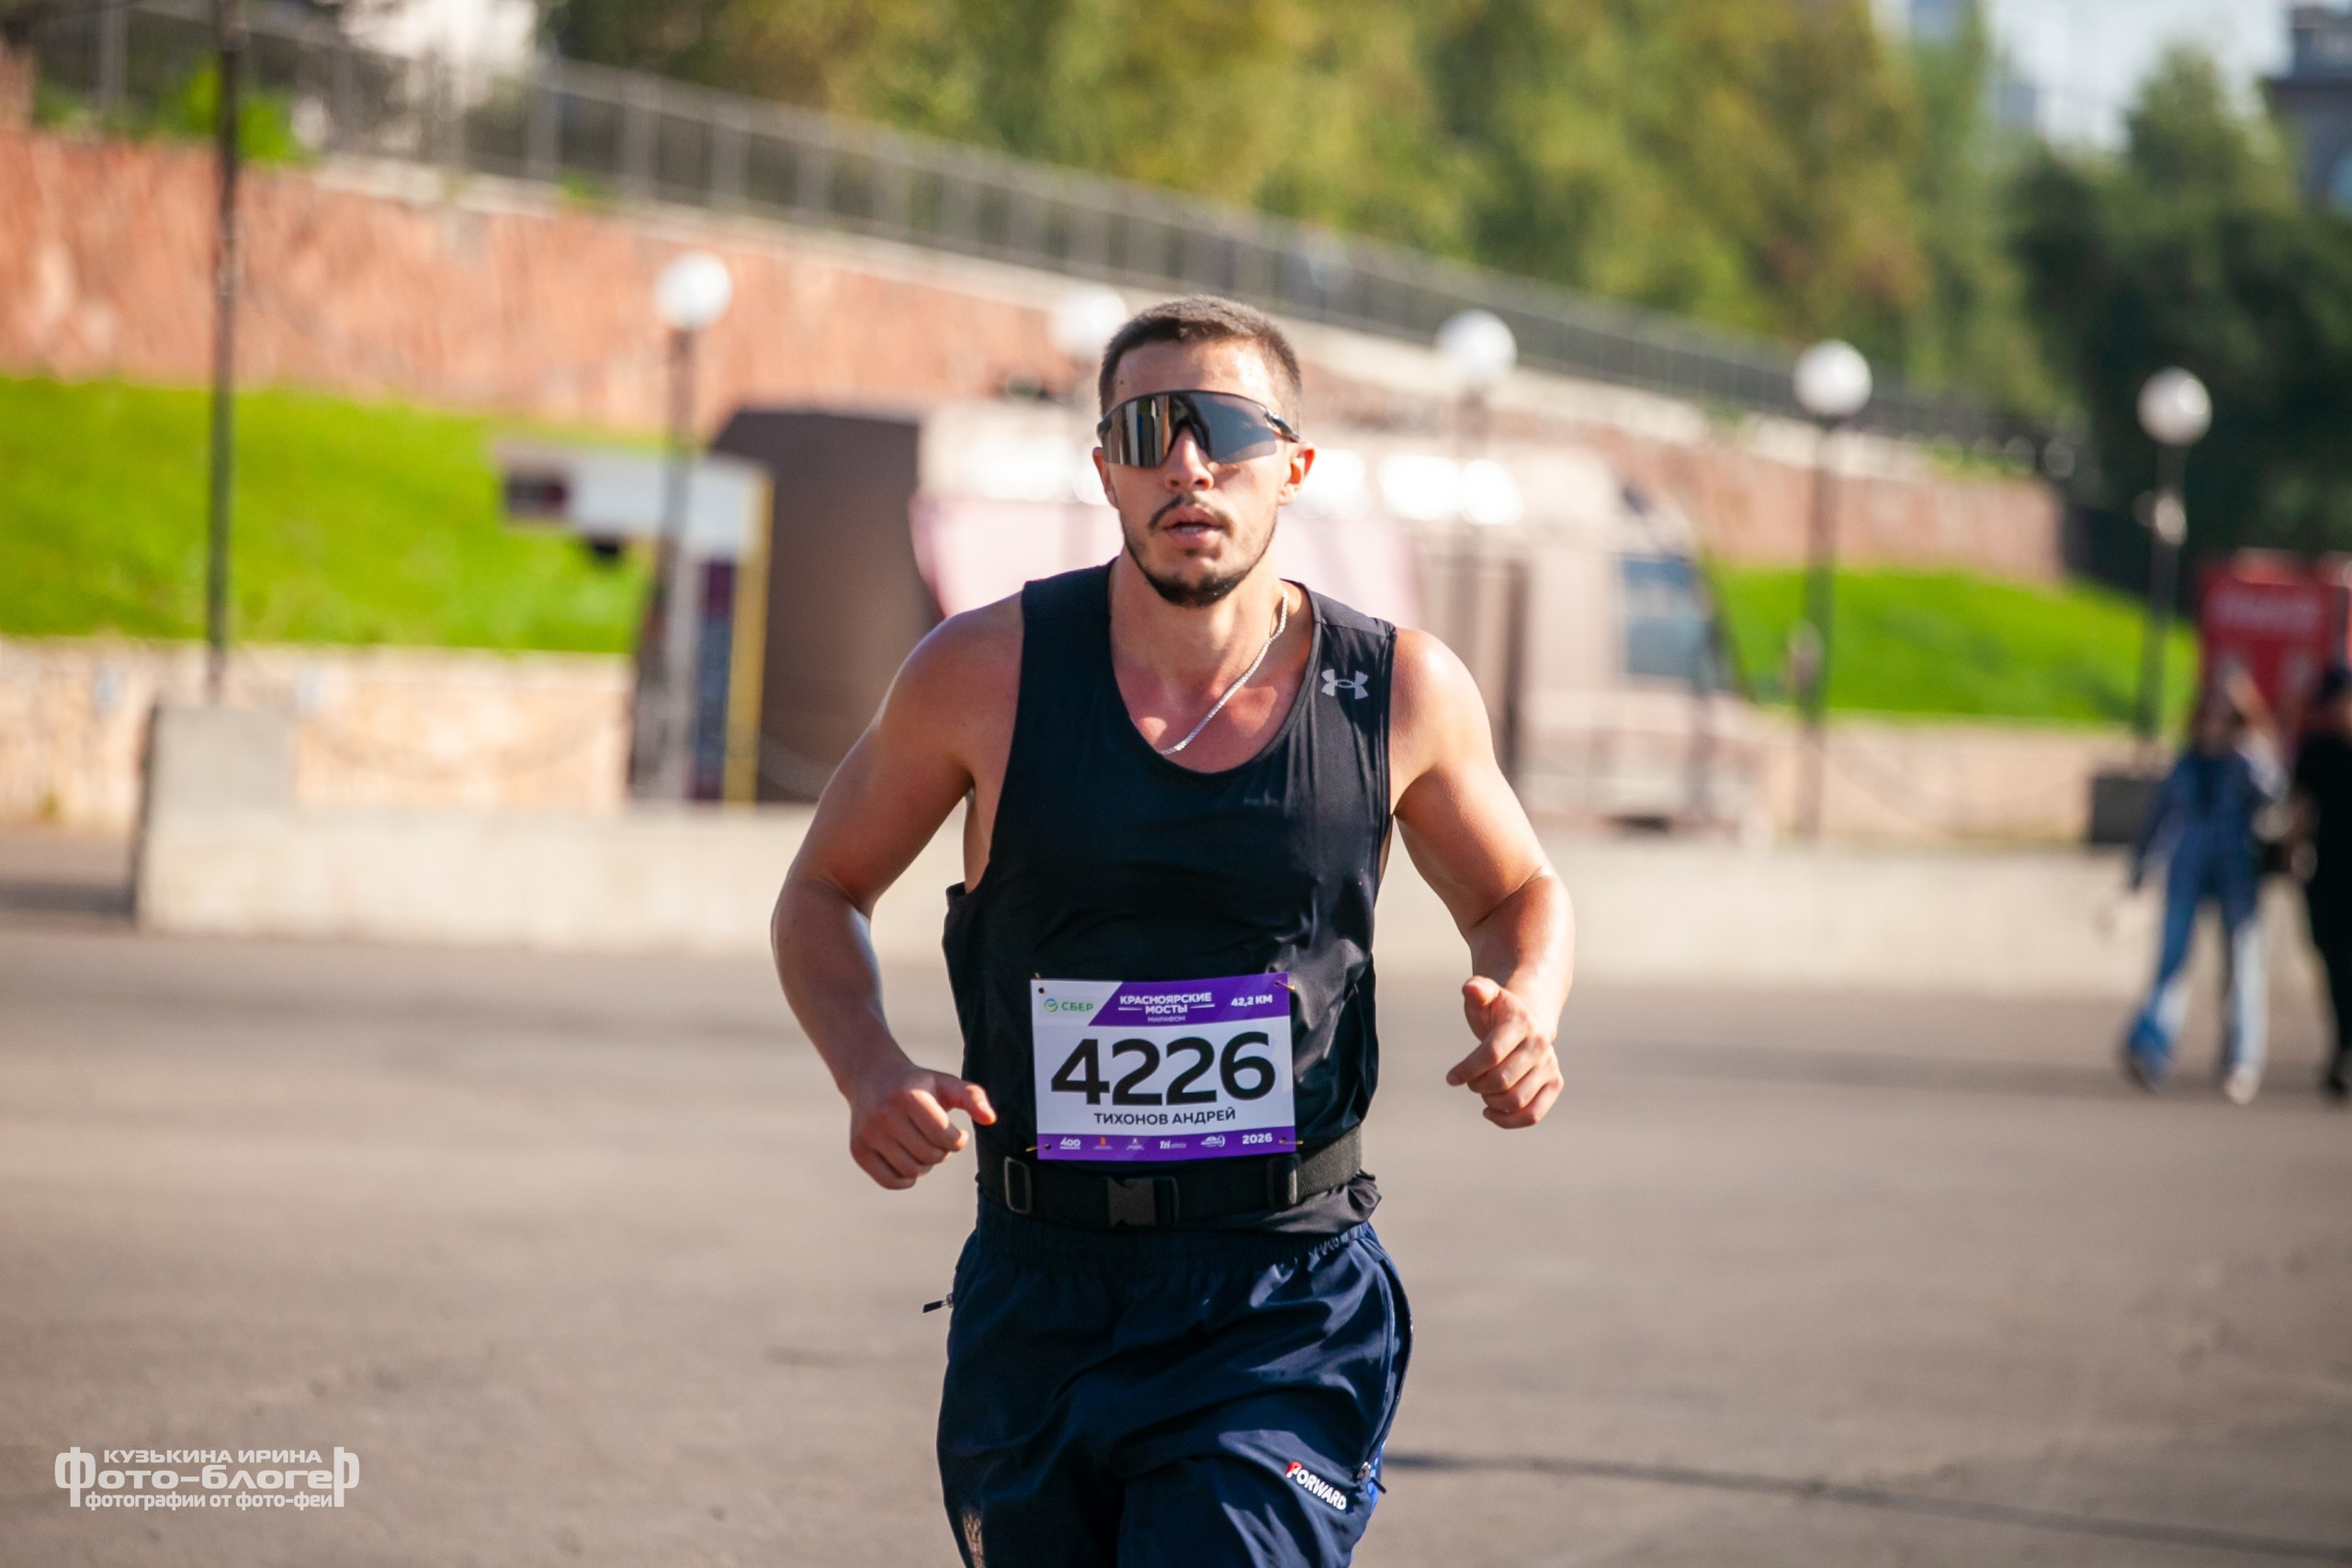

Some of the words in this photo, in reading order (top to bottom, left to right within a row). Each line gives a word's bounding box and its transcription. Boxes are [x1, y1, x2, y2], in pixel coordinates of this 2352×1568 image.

[1120, 992, 1213, 1005] КРАСНОЯРСКИЕ
[1231, 997, 1254, 1007] 42,2
[1256, 994, 1273, 1004] КМ
[1061, 1001, 1094, 1011] СБЕР
[1145, 1004, 1188, 1015] МОСТЫ
[1050, 1032, 1276, 1106] 4226
[1094, 1112, 1169, 1125] ТИХОНОВ
[1171, 1107, 1236, 1125] АНДРЕЙ
[1242, 1133, 1273, 1145] 2026
[1286, 1461, 1347, 1510] FORWARD
